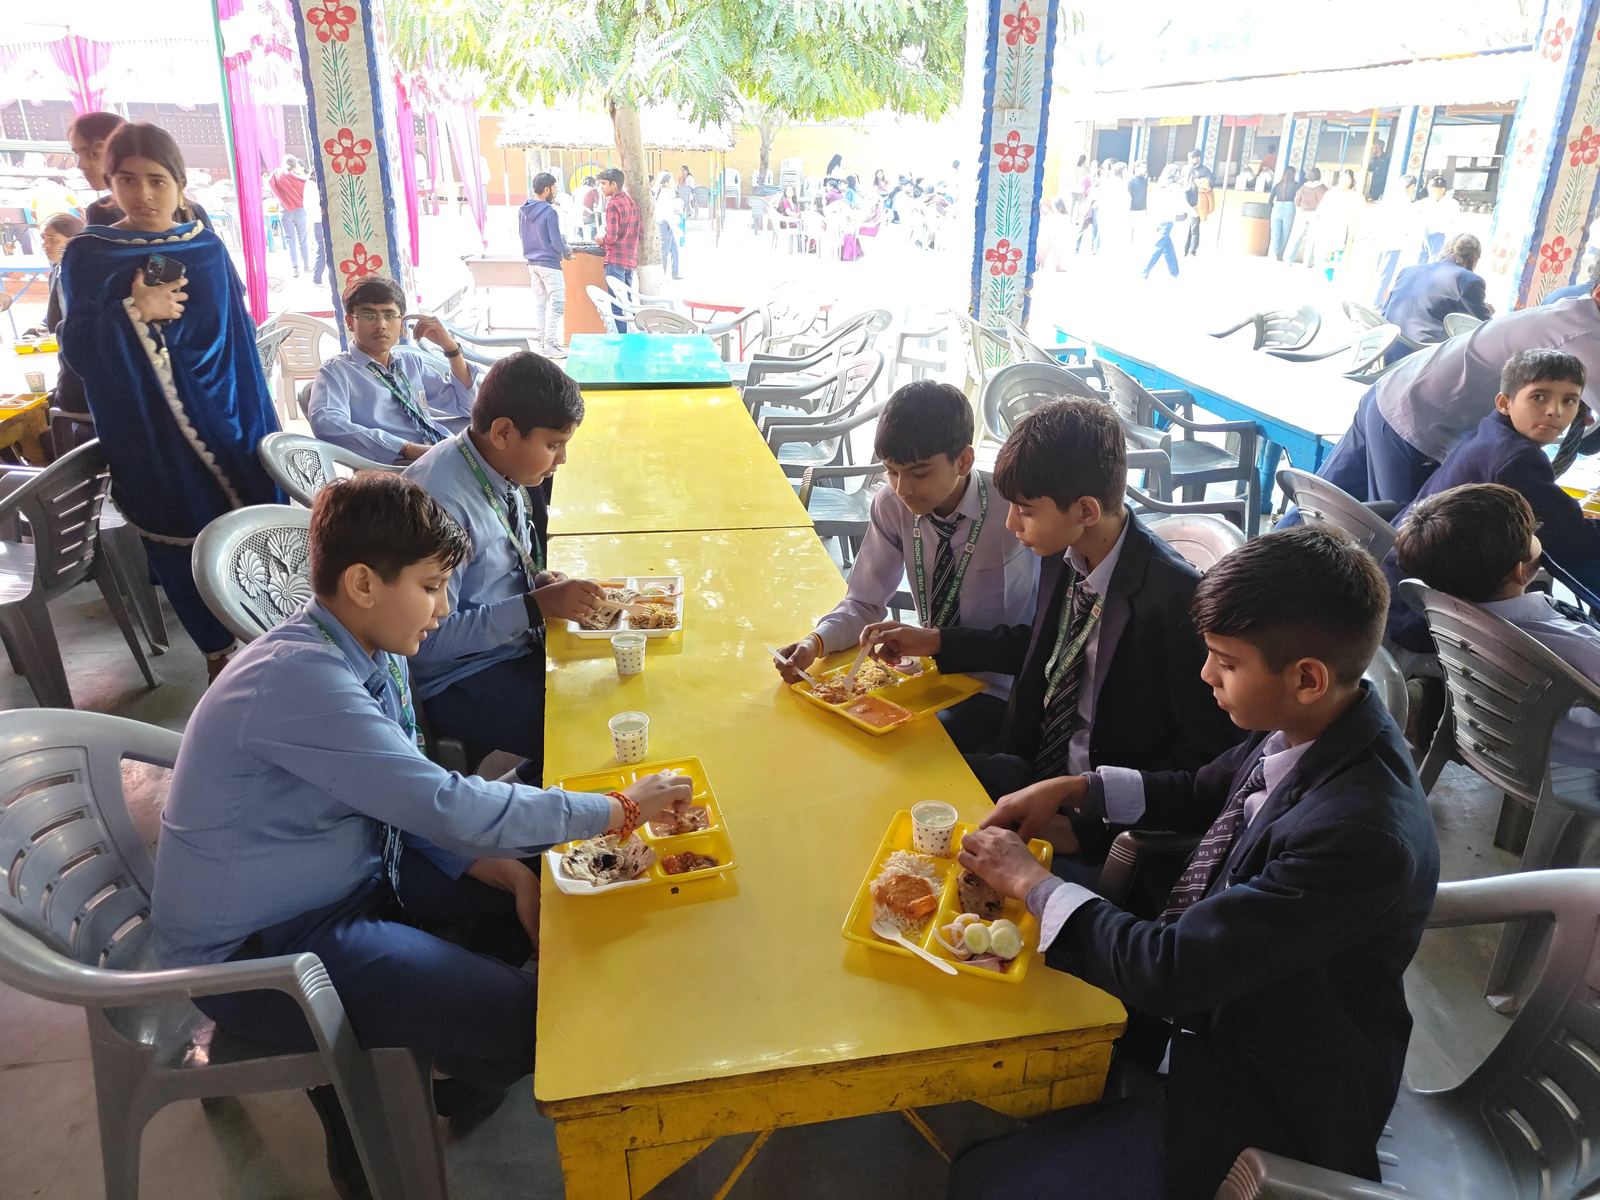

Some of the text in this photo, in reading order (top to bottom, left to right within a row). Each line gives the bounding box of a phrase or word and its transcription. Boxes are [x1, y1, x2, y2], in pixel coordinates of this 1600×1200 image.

[914, 539, 927, 621] NAVYUG PUBLIC SCHOOL
[947, 580, 959, 602] PUBLIC
[956, 553, 970, 578] SCHOOL
[1060, 646, 1078, 671] PUBLIC
[1077, 617, 1095, 645] SCHOOL
